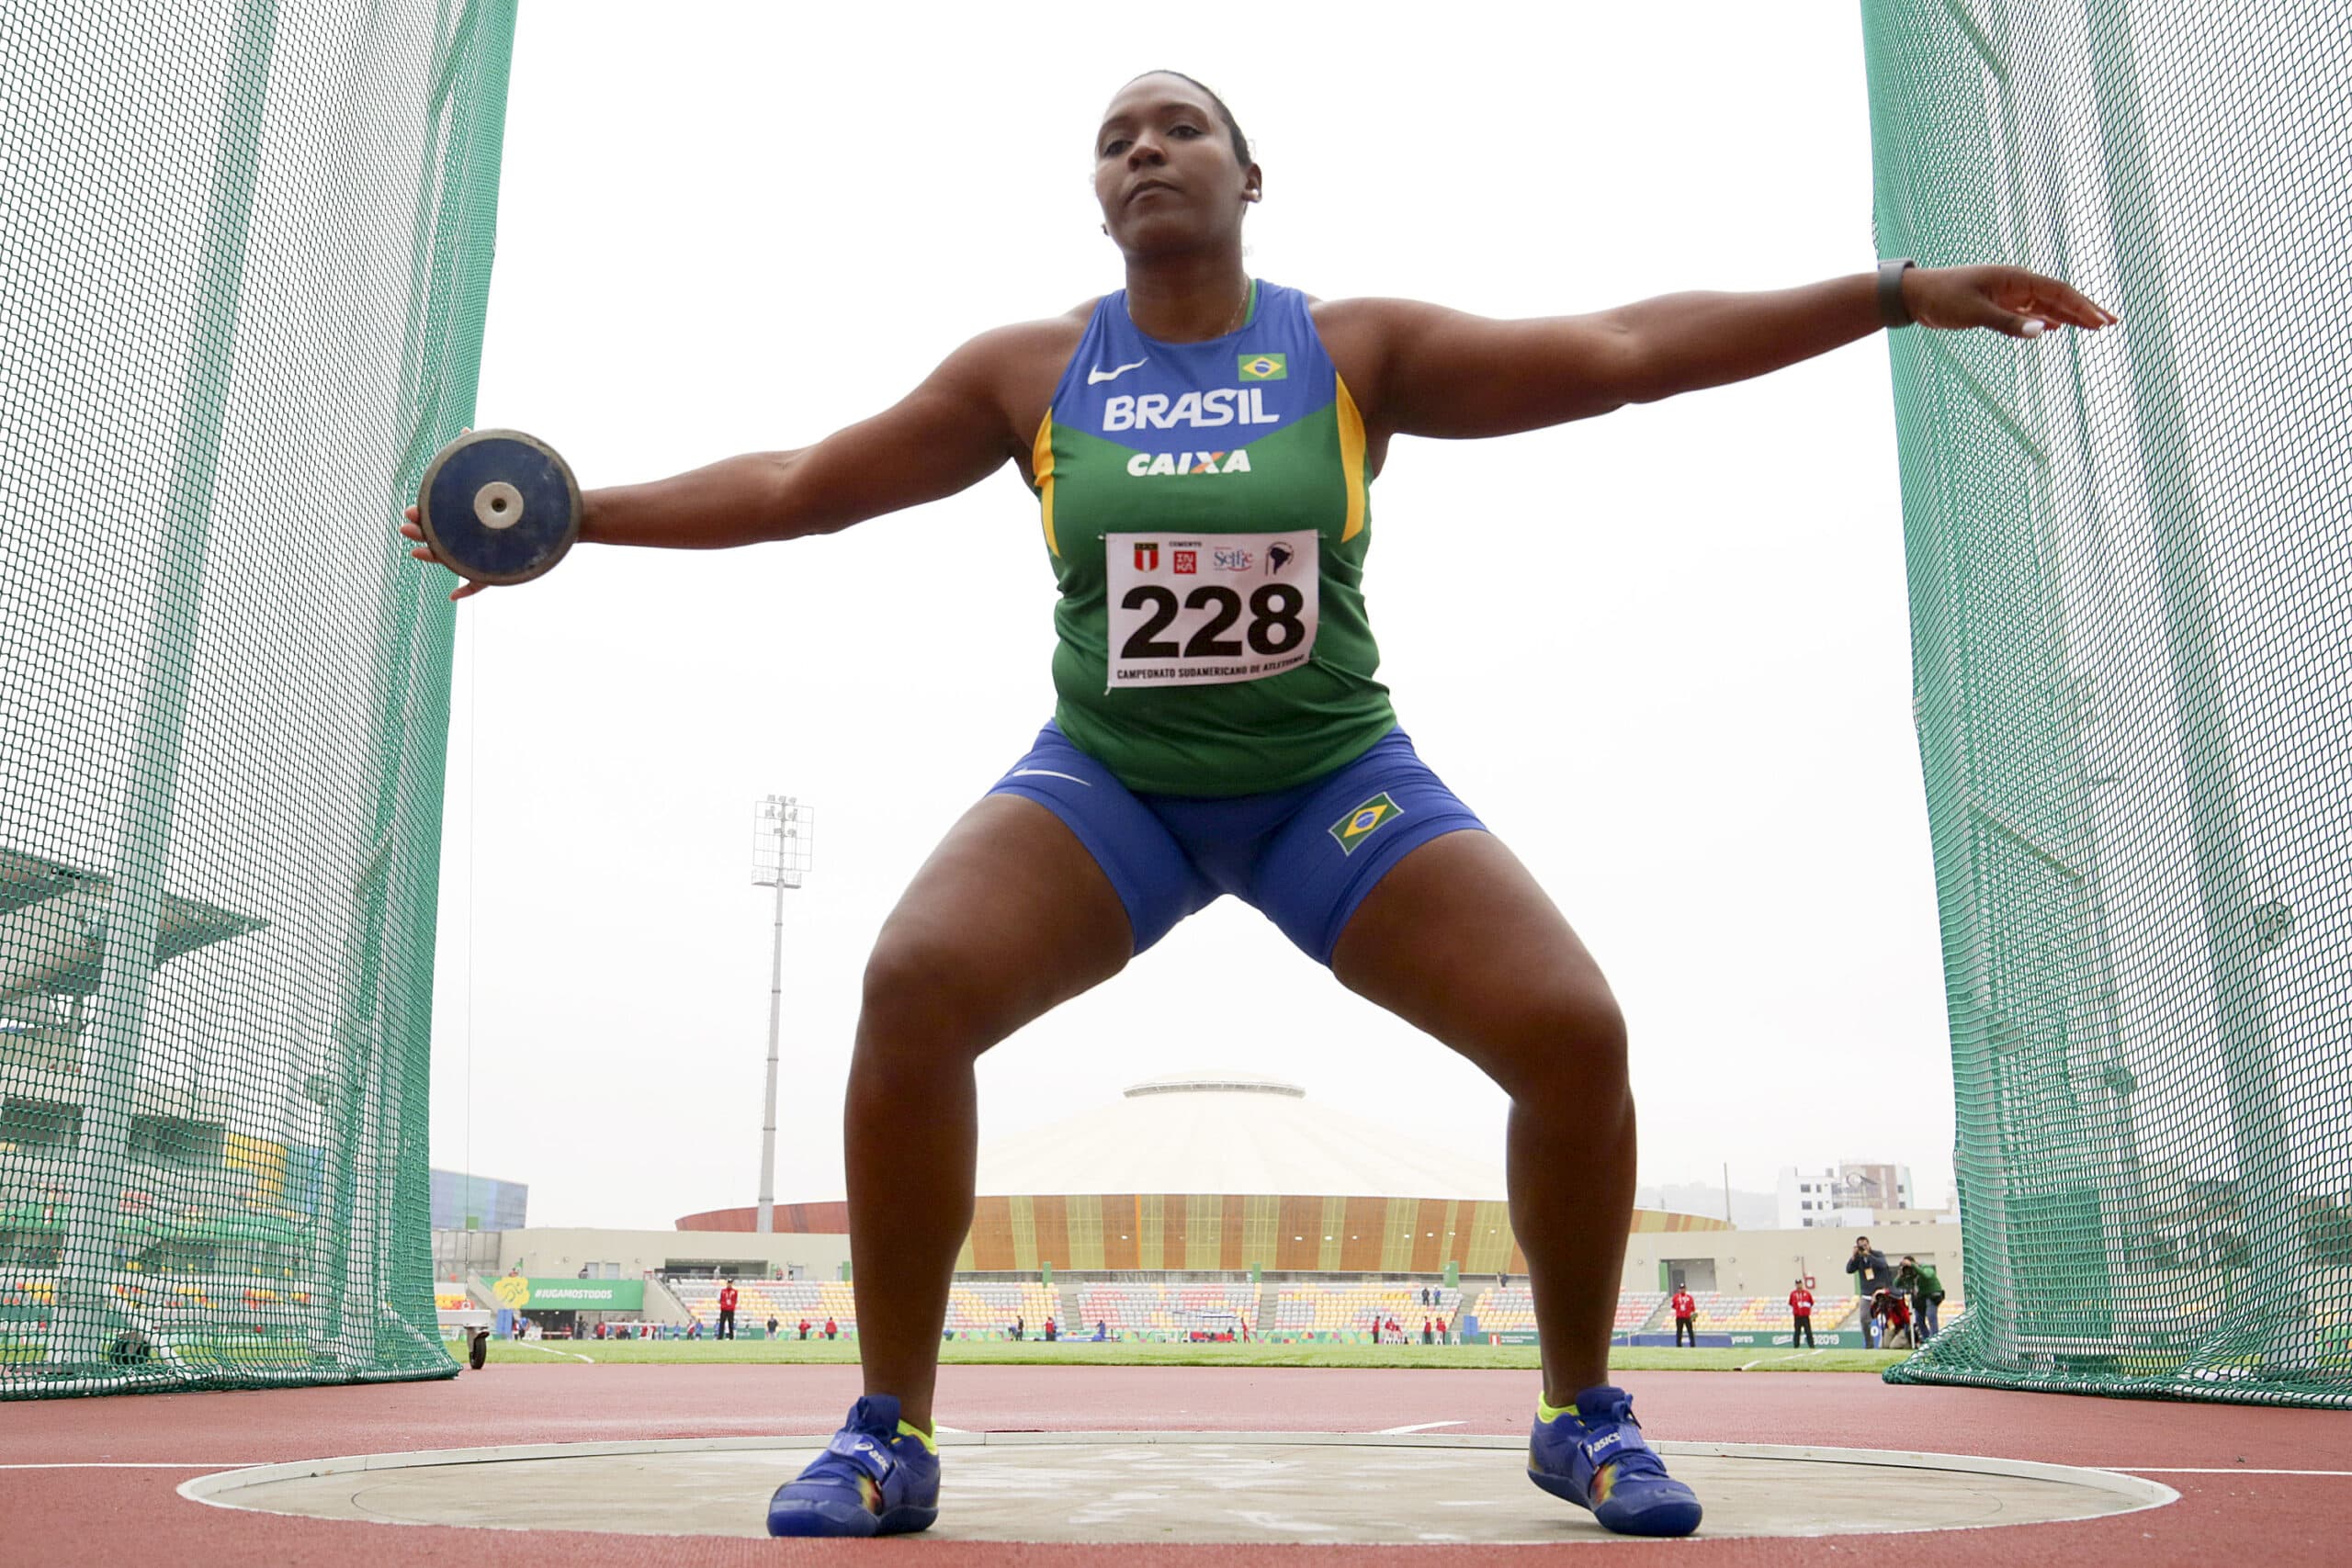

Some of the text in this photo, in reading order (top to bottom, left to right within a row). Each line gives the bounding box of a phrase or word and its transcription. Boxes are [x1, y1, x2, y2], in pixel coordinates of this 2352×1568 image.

[1102, 388, 1280, 432] BRASIL
[1126, 449, 1251, 477] CAIXA
[1121, 583, 1306, 659] 228
[1117, 669, 1176, 679] CAMPEONATO
[1179, 666, 1248, 678] SUDAMERICANO
[1250, 664, 1260, 674] DE
[535, 1289, 613, 1300] #JUGAMOSTODOS
[1593, 1432, 1621, 1452] asics
[868, 1450, 889, 1472] asic
